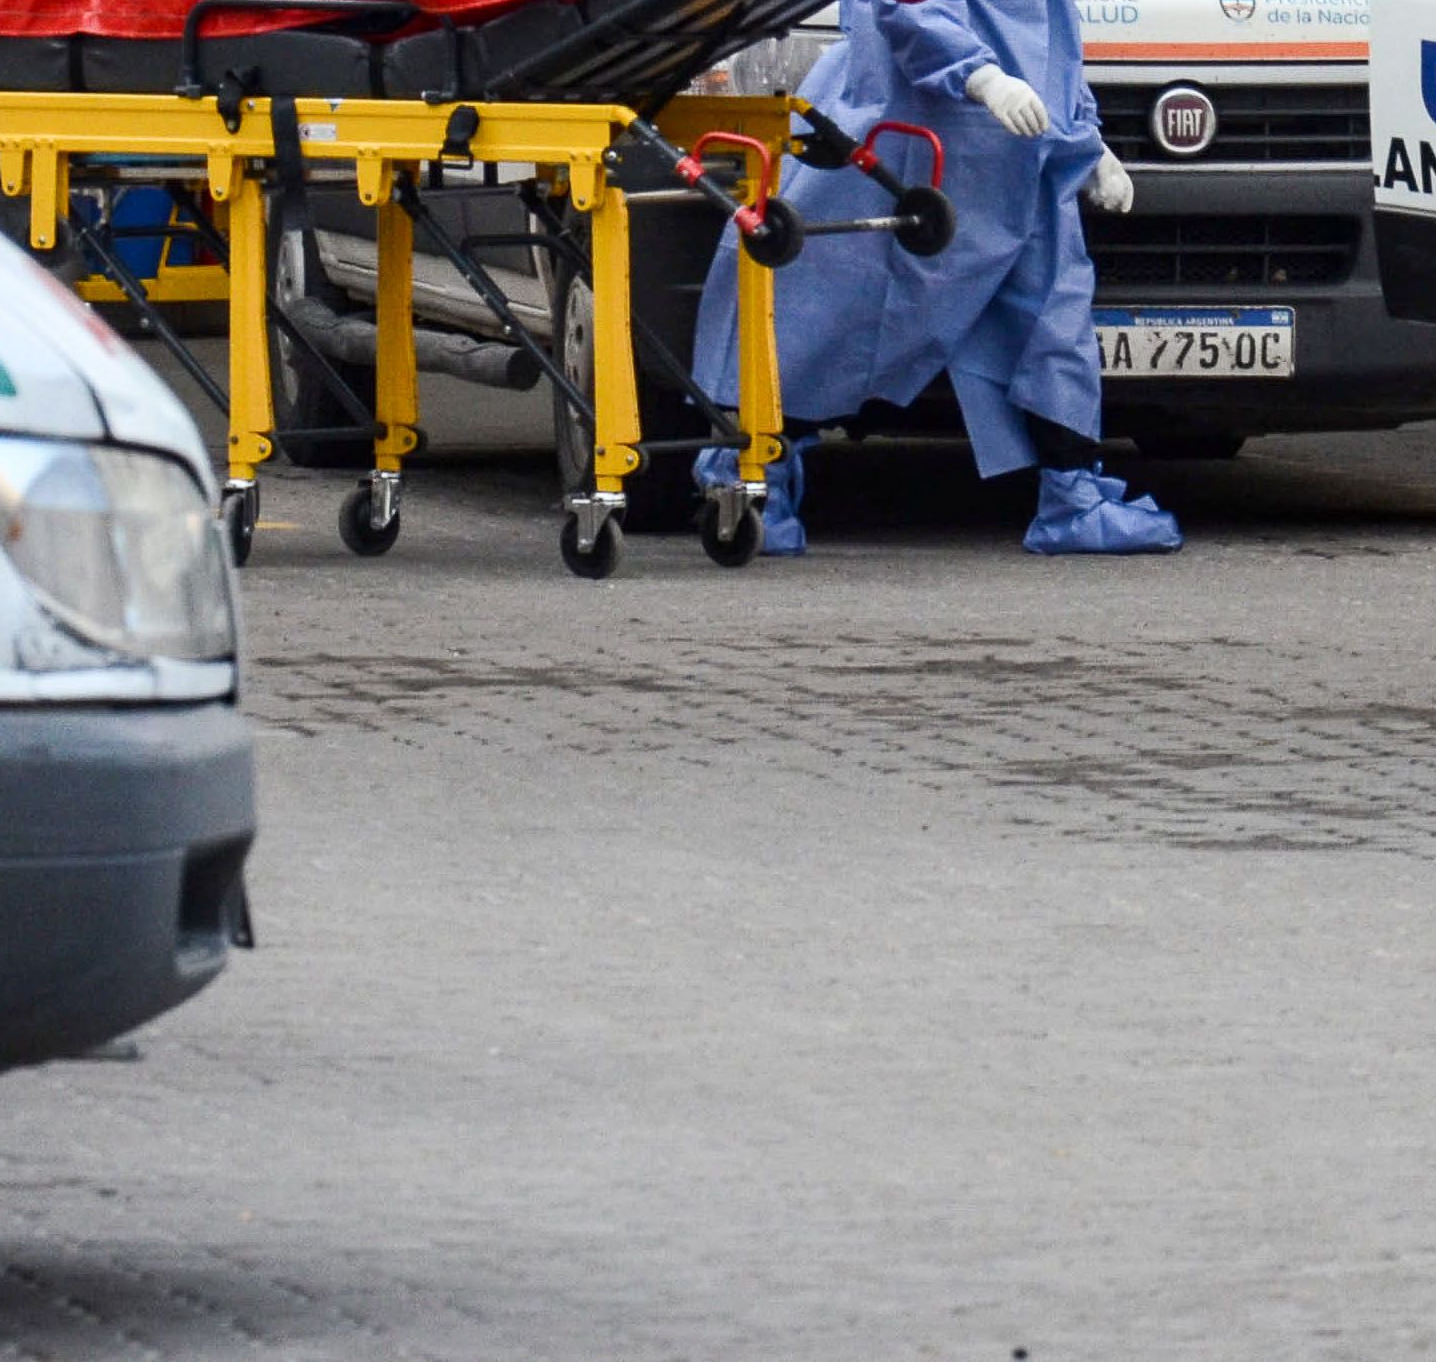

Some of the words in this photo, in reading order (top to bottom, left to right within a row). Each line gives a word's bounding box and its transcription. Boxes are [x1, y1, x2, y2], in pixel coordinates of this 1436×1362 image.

[1267, 8, 1291, 24] de
[1297, 7, 1312, 24] la
[1167, 108, 1203, 137] FIAT
